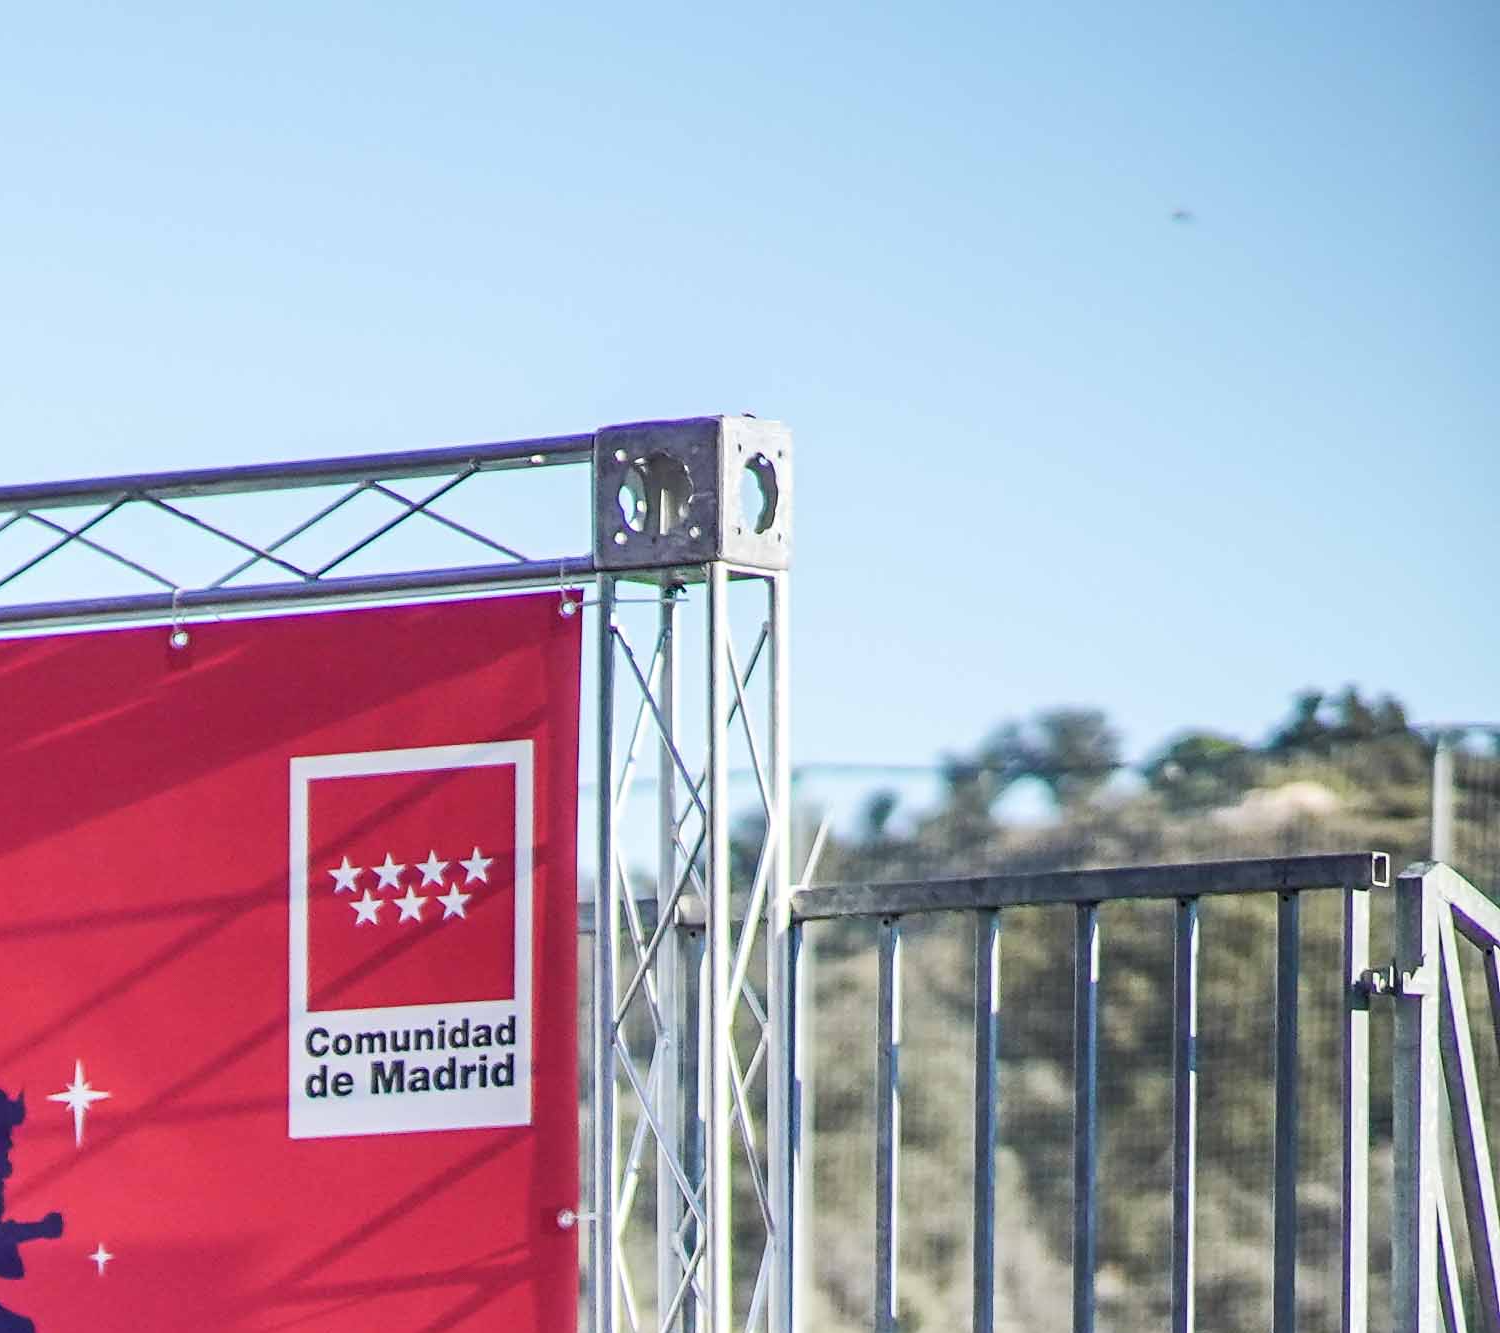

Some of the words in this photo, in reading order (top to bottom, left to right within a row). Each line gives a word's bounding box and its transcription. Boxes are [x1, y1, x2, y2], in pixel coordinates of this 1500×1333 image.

[305, 1014, 517, 1059] Comunidad
[305, 1063, 354, 1099] de
[370, 1052, 516, 1095] Madrid
